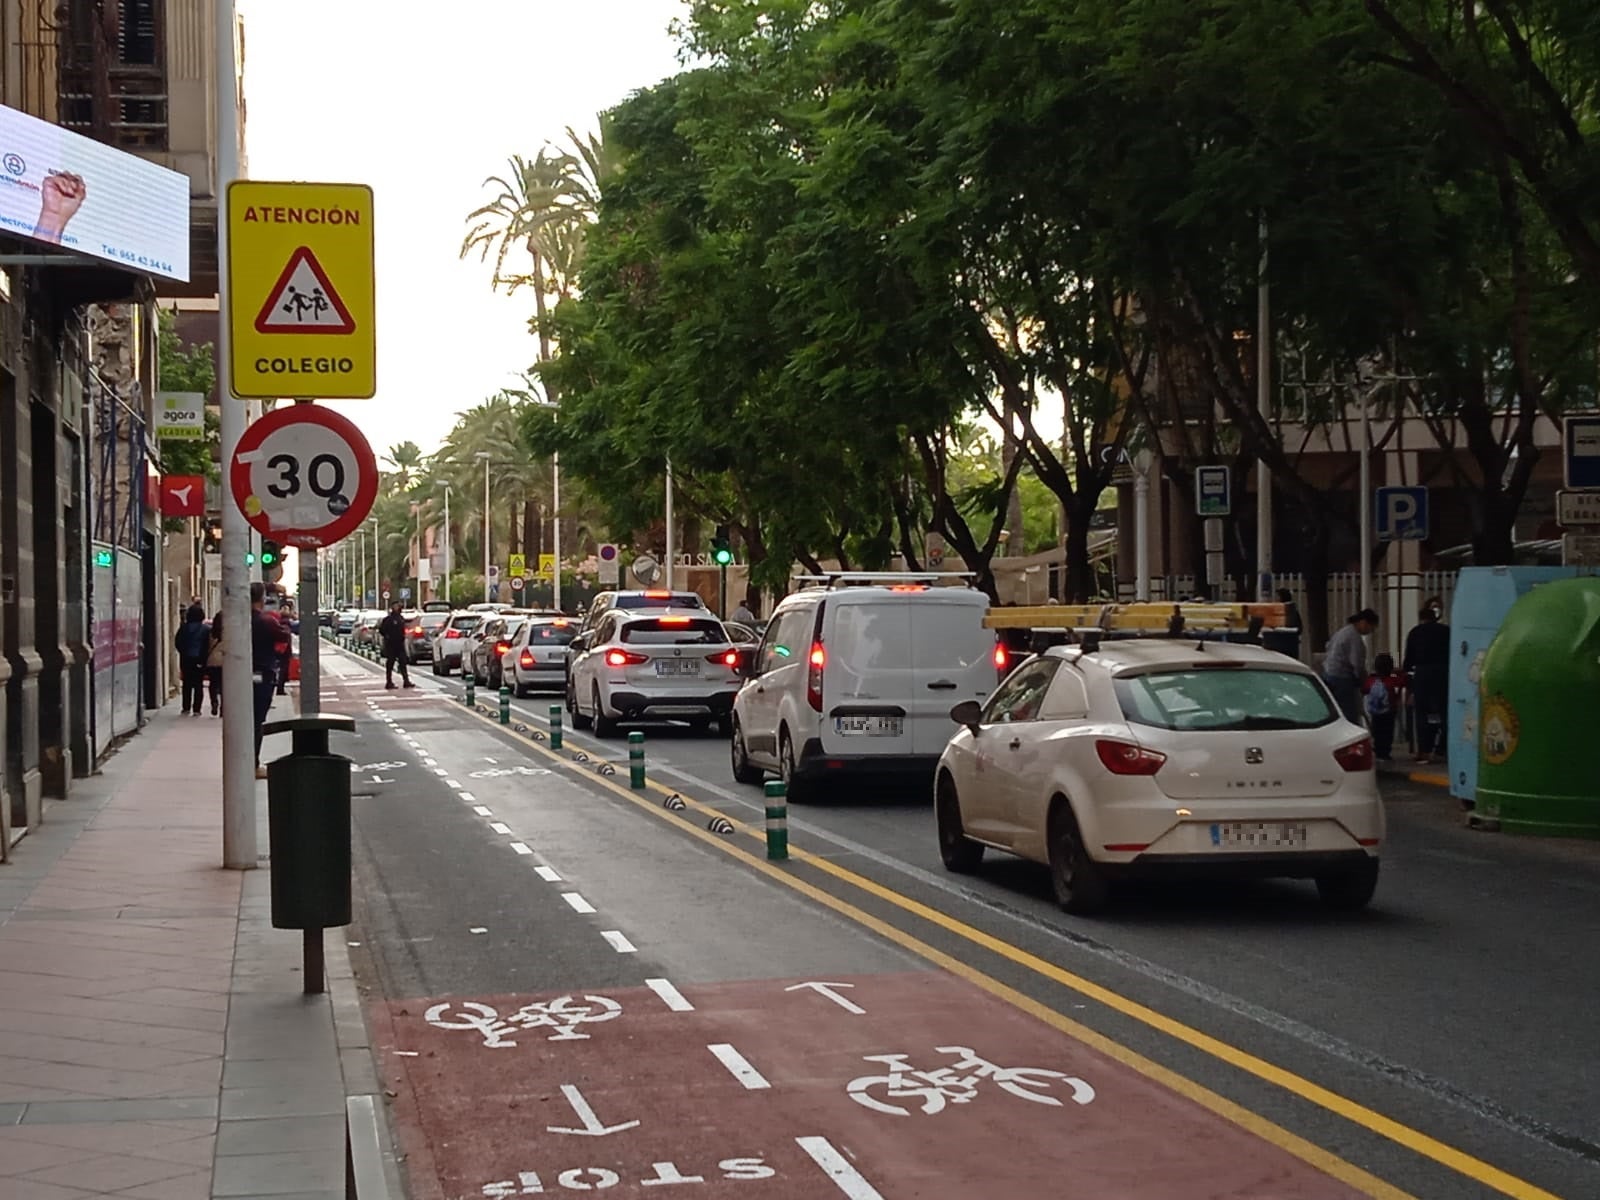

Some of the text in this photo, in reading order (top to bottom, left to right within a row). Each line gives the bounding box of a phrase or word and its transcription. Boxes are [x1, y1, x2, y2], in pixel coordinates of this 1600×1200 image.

[244, 204, 360, 225] ATENCIÓN
[255, 357, 354, 374] COLEGIO
[163, 410, 196, 422] agora
[267, 453, 344, 499] 30
[1387, 493, 1417, 537] P
[482, 1157, 776, 1197] STOP
